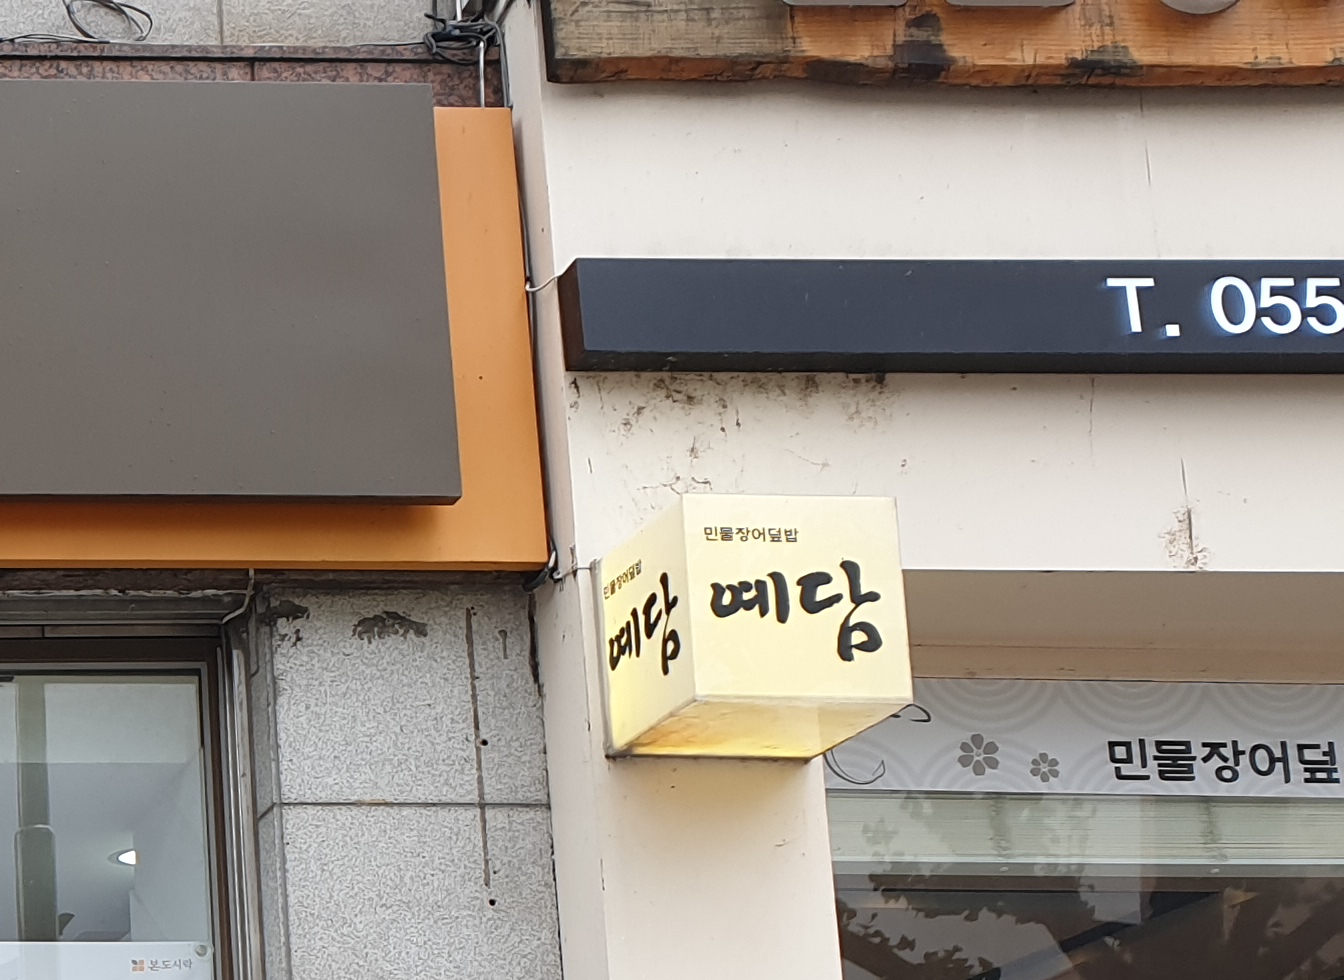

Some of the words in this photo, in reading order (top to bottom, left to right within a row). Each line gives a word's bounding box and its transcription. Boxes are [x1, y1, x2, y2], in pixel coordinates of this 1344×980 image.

[1105, 277, 1182, 339] T.
[1208, 275, 1344, 337] 055
[703, 526, 800, 543] 민물장어덮밥
[608, 571, 681, 676] 예담
[710, 559, 883, 662] 예담
[1107, 738, 1342, 785] 민물장어덮
[148, 958, 194, 973] 본도시락
